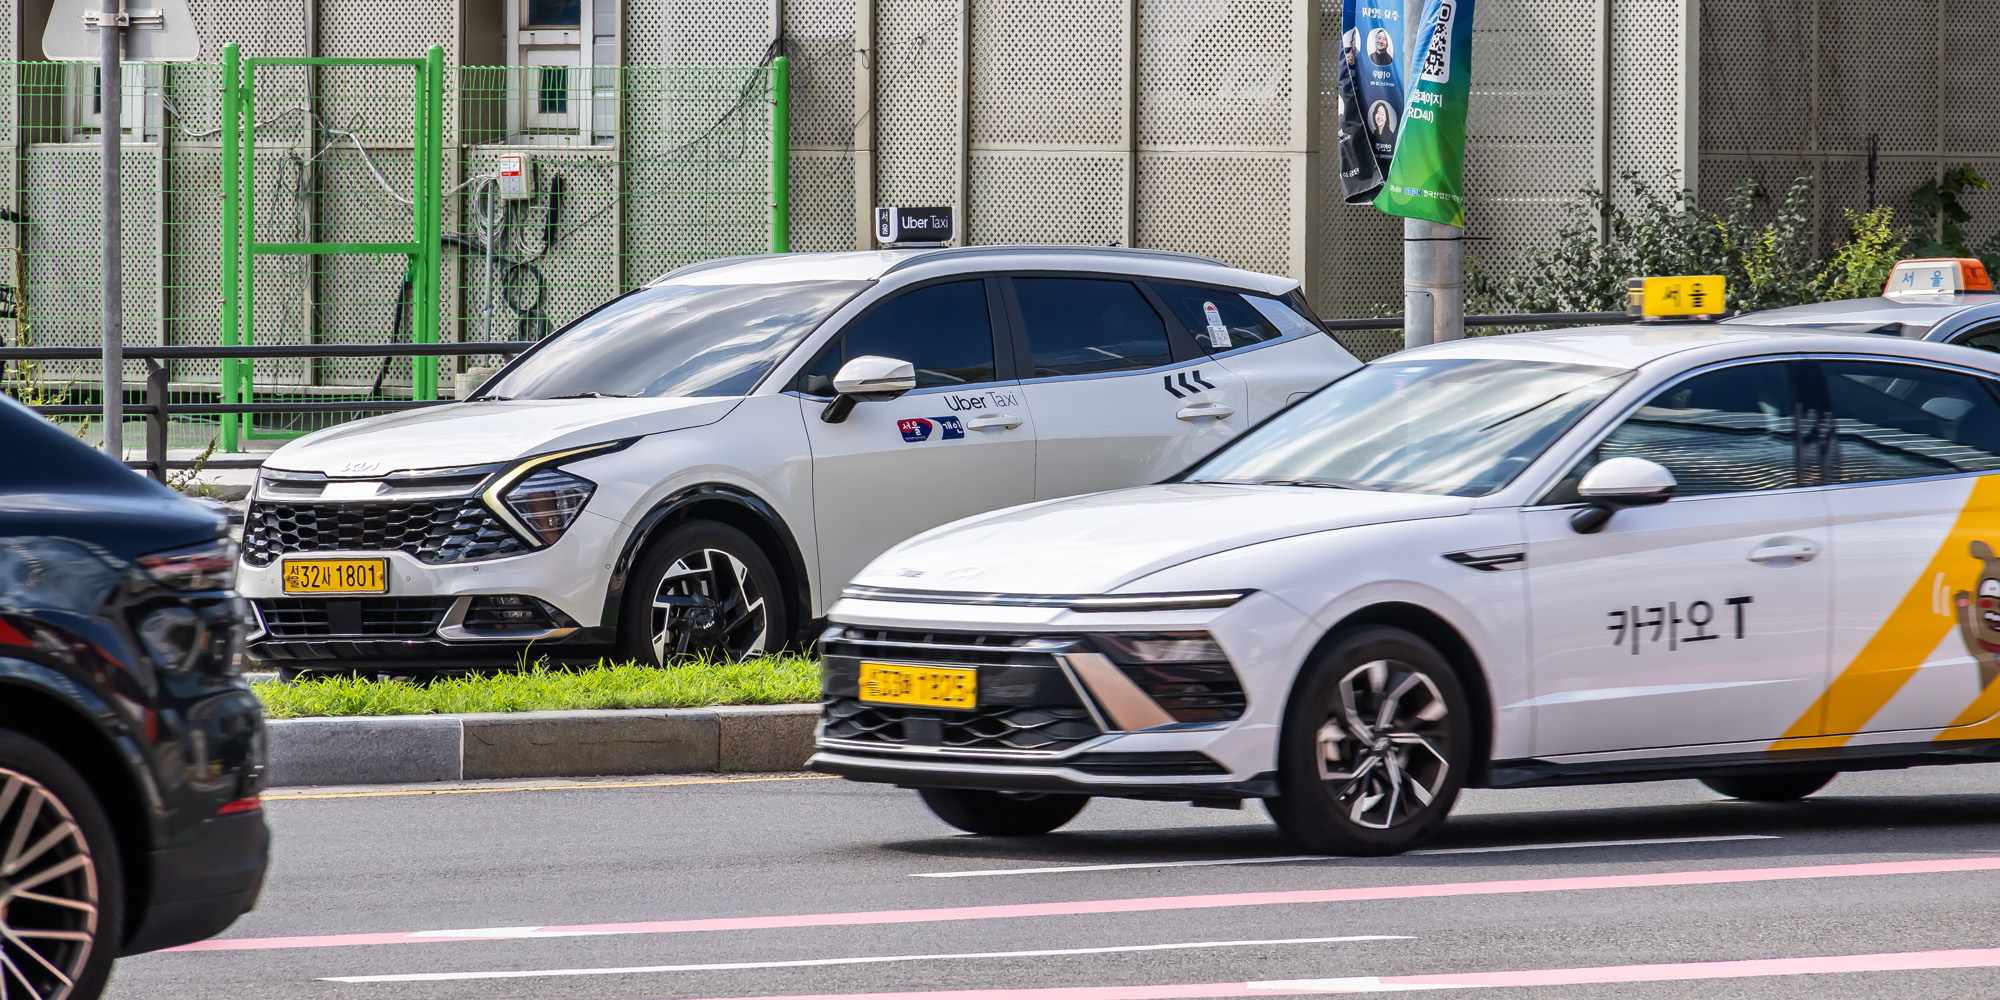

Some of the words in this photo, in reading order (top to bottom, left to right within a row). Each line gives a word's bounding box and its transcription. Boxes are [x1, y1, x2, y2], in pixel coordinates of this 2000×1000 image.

[902, 216, 928, 229] Uber
[930, 215, 949, 229] Taxi
[944, 395, 987, 412] Uber
[986, 391, 1019, 408] Taxi
[902, 420, 922, 436] 서울
[942, 420, 964, 434] 개인
[336, 564, 376, 588] 1801
[1606, 599, 1720, 655] 카카오
[1725, 595, 1755, 639] T
